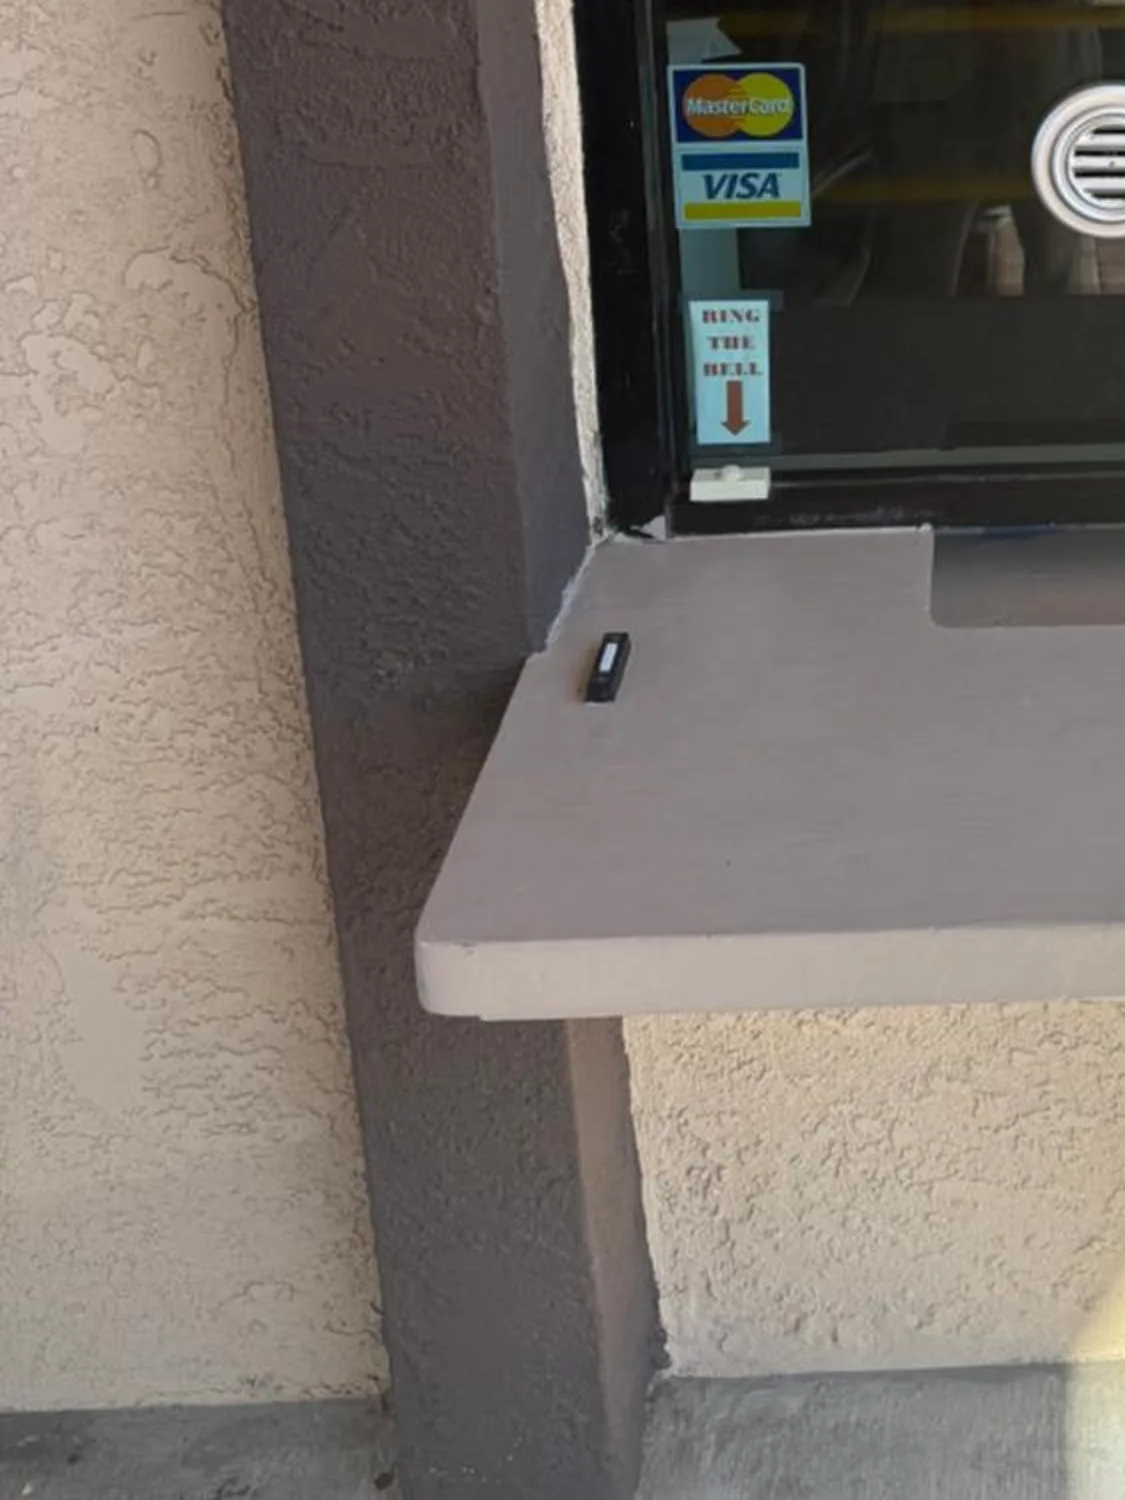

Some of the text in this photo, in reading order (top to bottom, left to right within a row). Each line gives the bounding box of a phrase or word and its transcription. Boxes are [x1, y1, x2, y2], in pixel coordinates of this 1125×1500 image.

[687, 97, 789, 115] MasterCard
[703, 172, 781, 200] VISA
[702, 308, 760, 324] RING
[707, 335, 756, 351] THE
[703, 362, 763, 377] BELL
